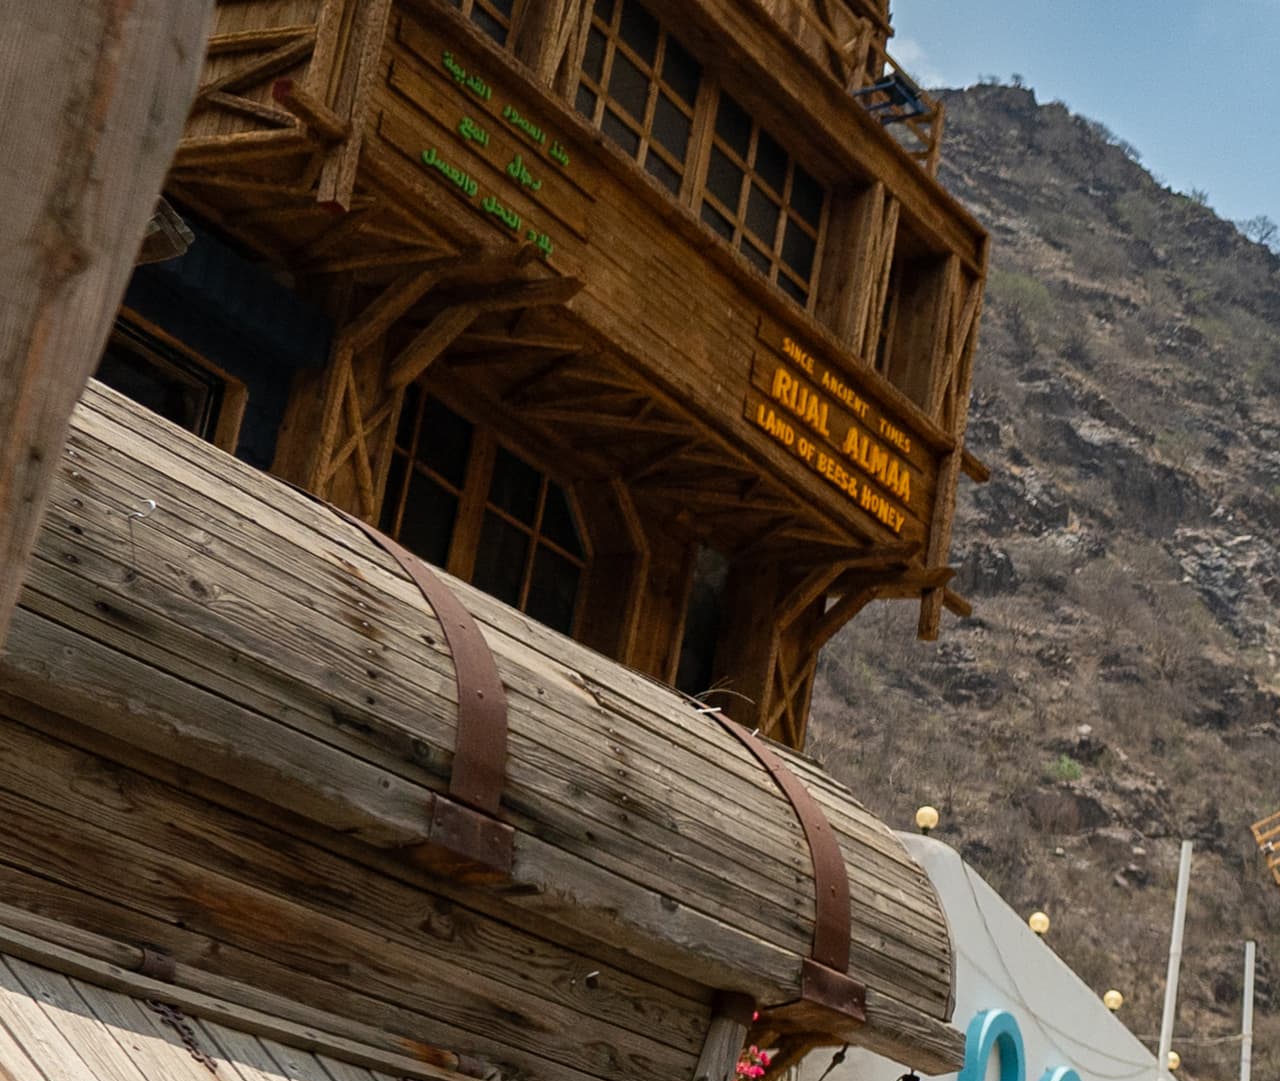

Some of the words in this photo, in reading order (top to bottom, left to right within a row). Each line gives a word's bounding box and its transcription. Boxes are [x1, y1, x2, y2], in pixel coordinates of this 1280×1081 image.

[772, 368, 829, 436] RIJAL
[844, 427, 911, 504] ALMAA
[783, 337, 815, 374] SINCE
[821, 371, 870, 418] ANCIENT
[879, 419, 911, 453] TIMES
[757, 404, 794, 445] LAND
[798, 438, 815, 461] OF
[861, 485, 904, 533] HONEY
